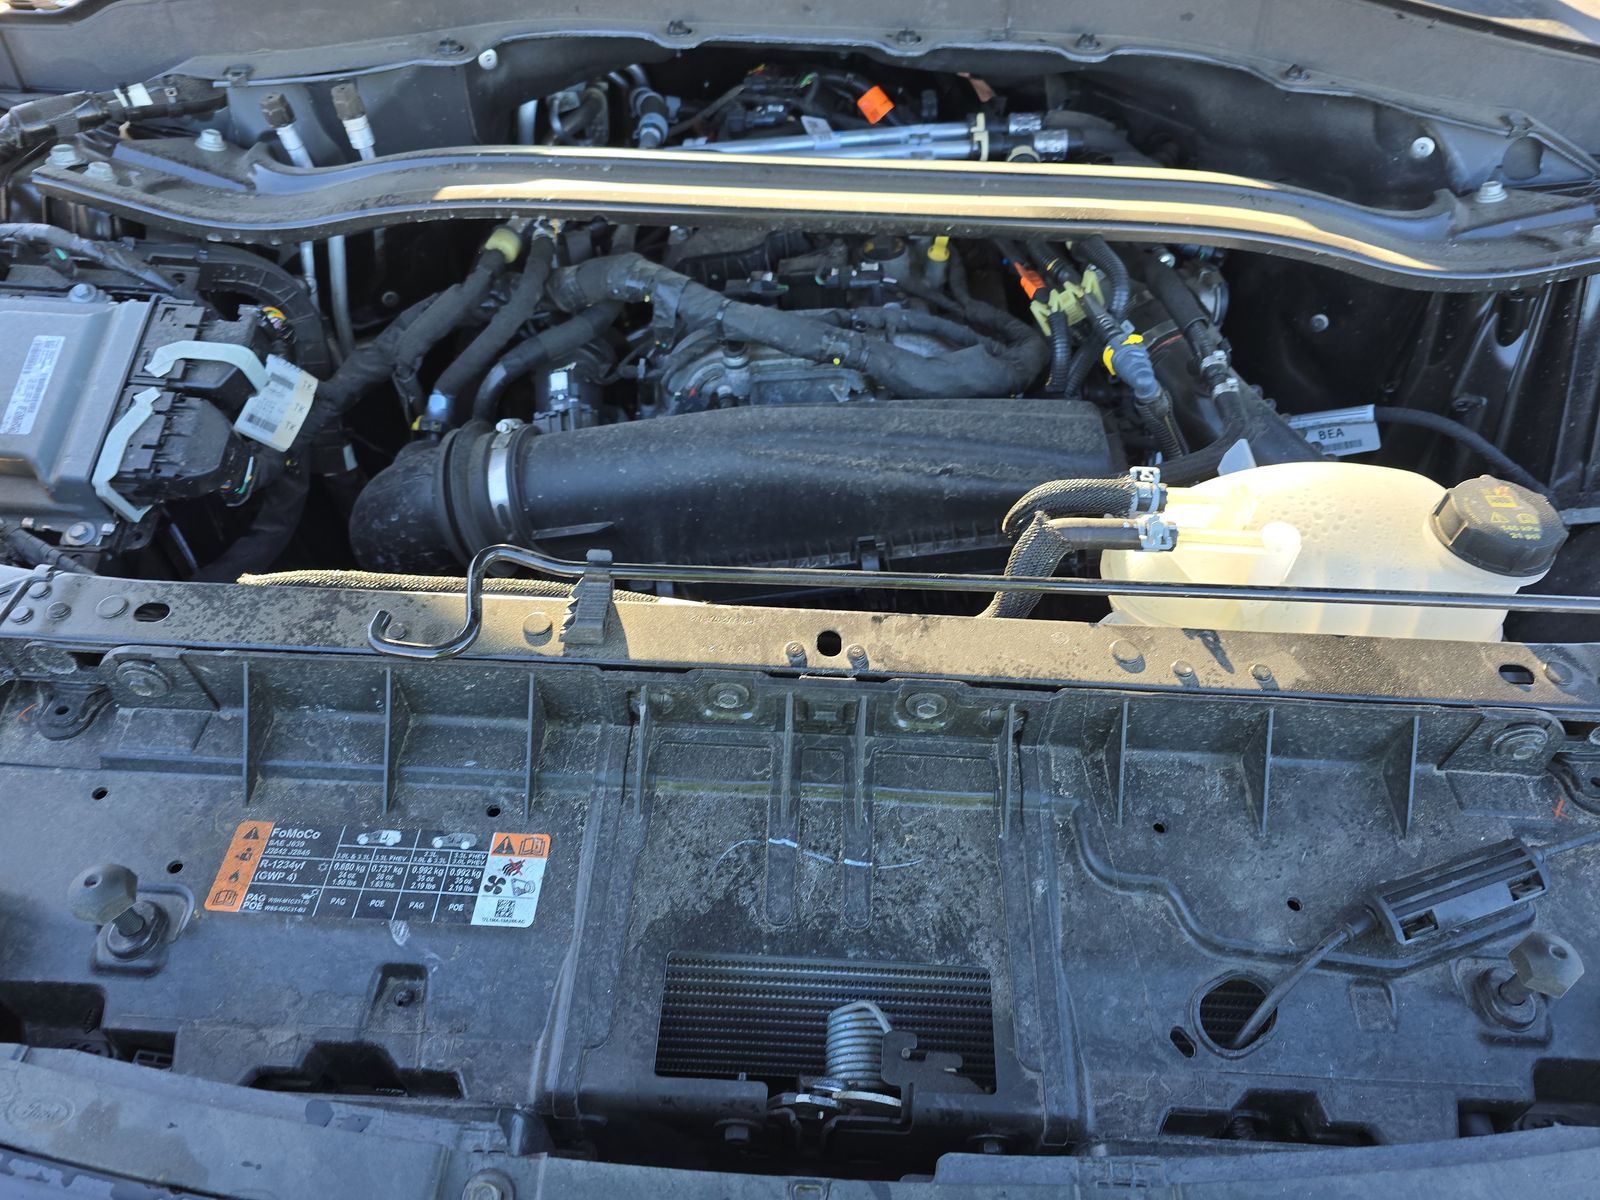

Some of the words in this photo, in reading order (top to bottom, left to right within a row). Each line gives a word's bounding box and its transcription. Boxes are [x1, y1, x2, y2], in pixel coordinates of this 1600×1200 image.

[1318, 428, 1345, 440] BEA
[270, 827, 321, 840] FoMoCo
[268, 839, 286, 847] SAE
[260, 859, 307, 872] R-1234yf
[355, 863, 366, 874] kg
[370, 864, 393, 873] 0.737
[392, 865, 404, 876] kg
[411, 865, 433, 875] 0.992
[433, 867, 445, 877] kg
[449, 868, 471, 877] 0.992
[471, 869, 483, 880] kg
[254, 870, 285, 882] (GWP
[286, 872, 298, 884] 4)
[346, 879, 357, 887] lbs
[410, 881, 425, 890] 2.19
[425, 882, 437, 890] lbs
[448, 883, 463, 892] 2.19
[463, 884, 474, 893] lbs
[245, 893, 267, 903] PAG
[329, 897, 347, 906] PAG
[242, 900, 264, 911] POE
[368, 899, 386, 908] POE
[408, 901, 425, 910] PAG
[447, 902, 465, 912] POE
